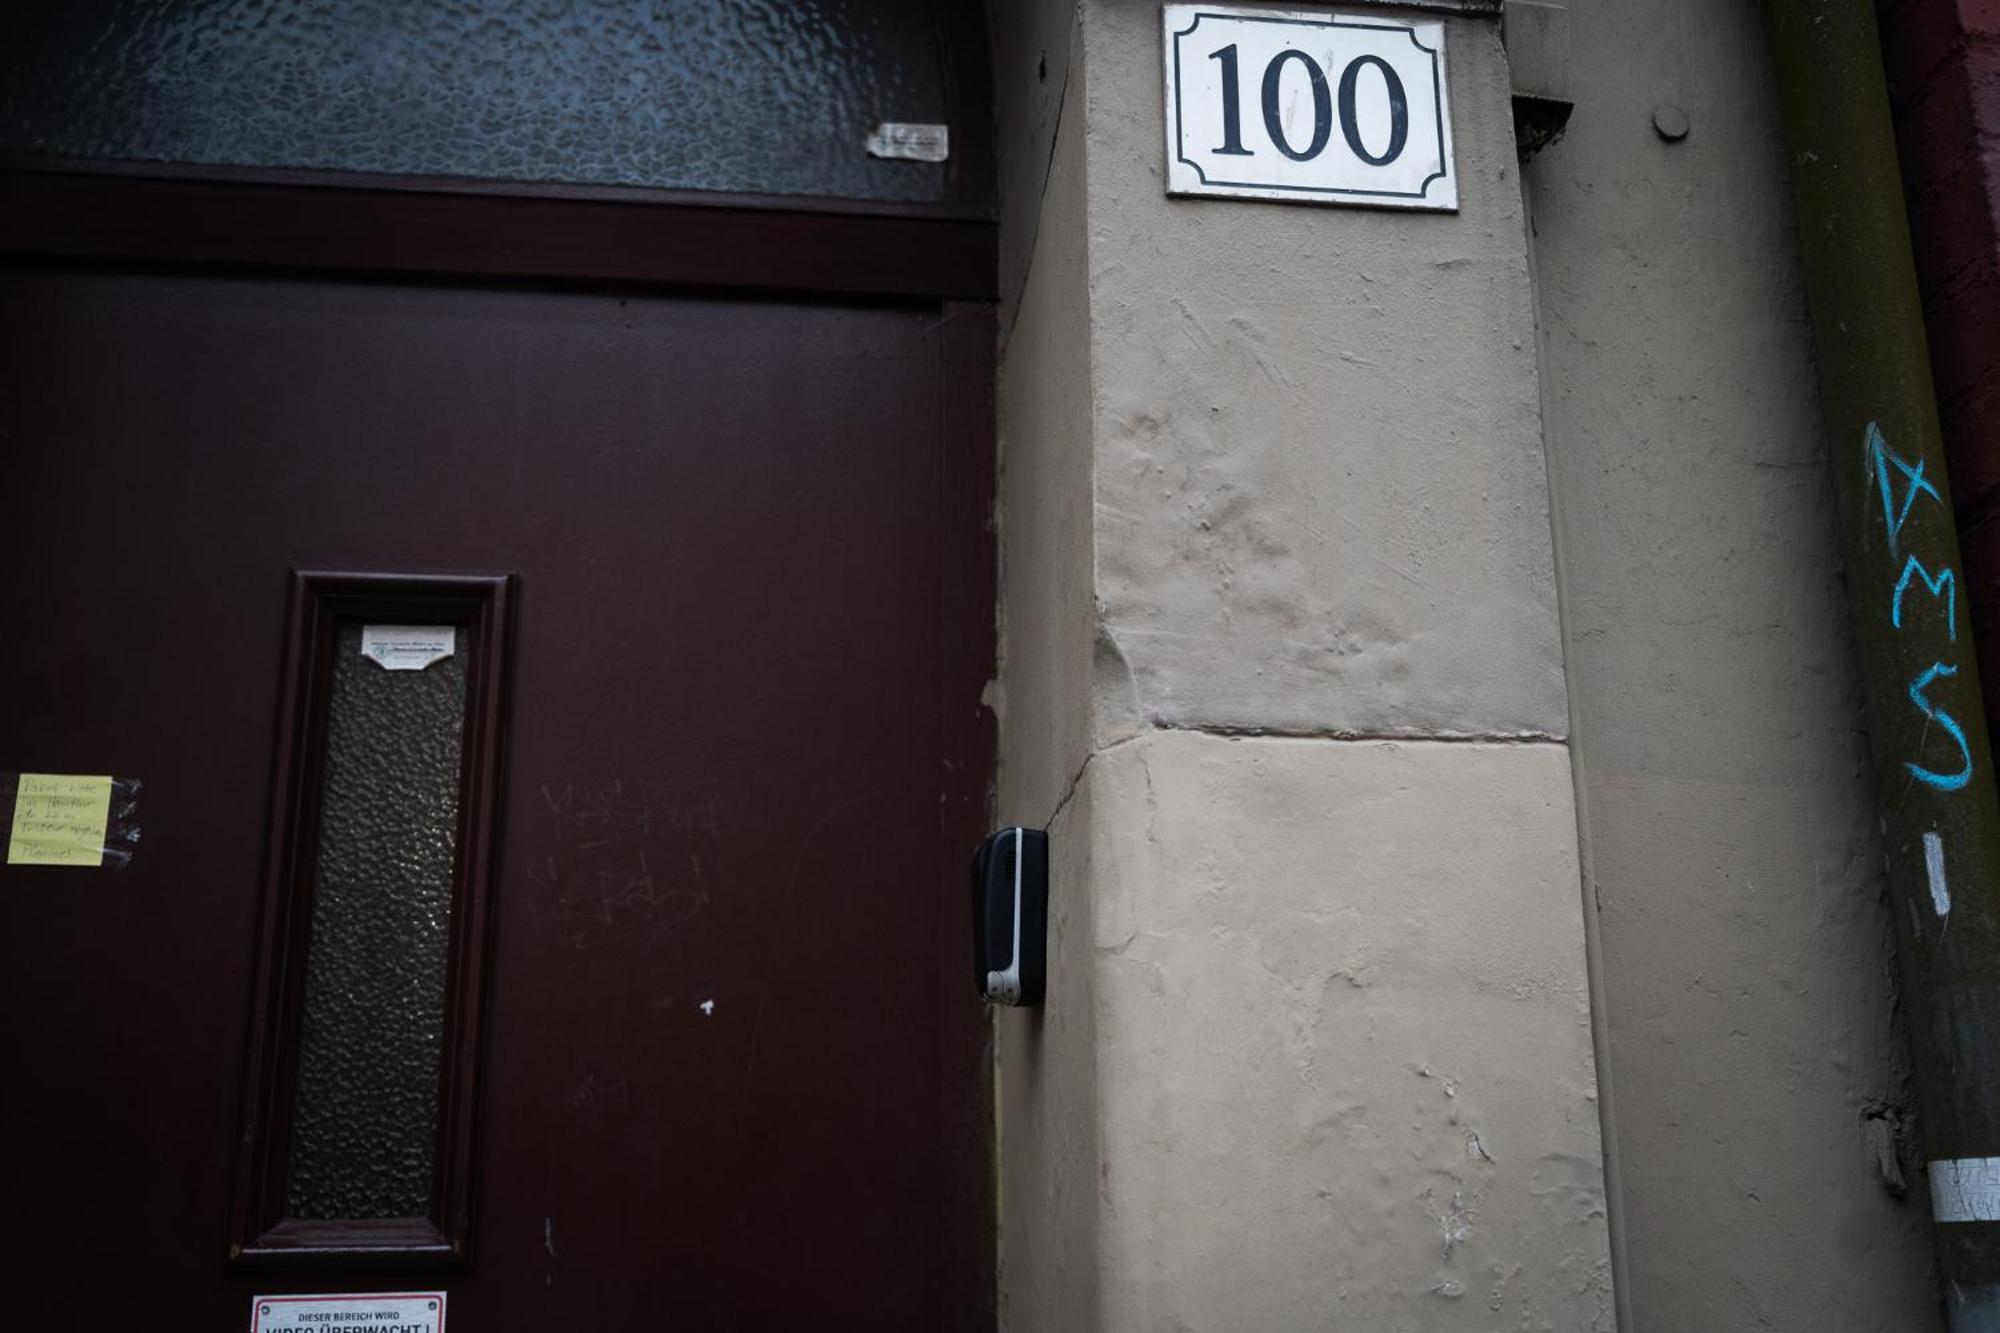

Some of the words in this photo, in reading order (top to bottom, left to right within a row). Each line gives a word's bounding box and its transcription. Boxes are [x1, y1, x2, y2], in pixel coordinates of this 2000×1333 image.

[1208, 43, 1409, 167] 100
[298, 1312, 331, 1322] DIESER
[333, 1312, 372, 1321] BEREICH
[373, 1311, 400, 1320] WIRD
